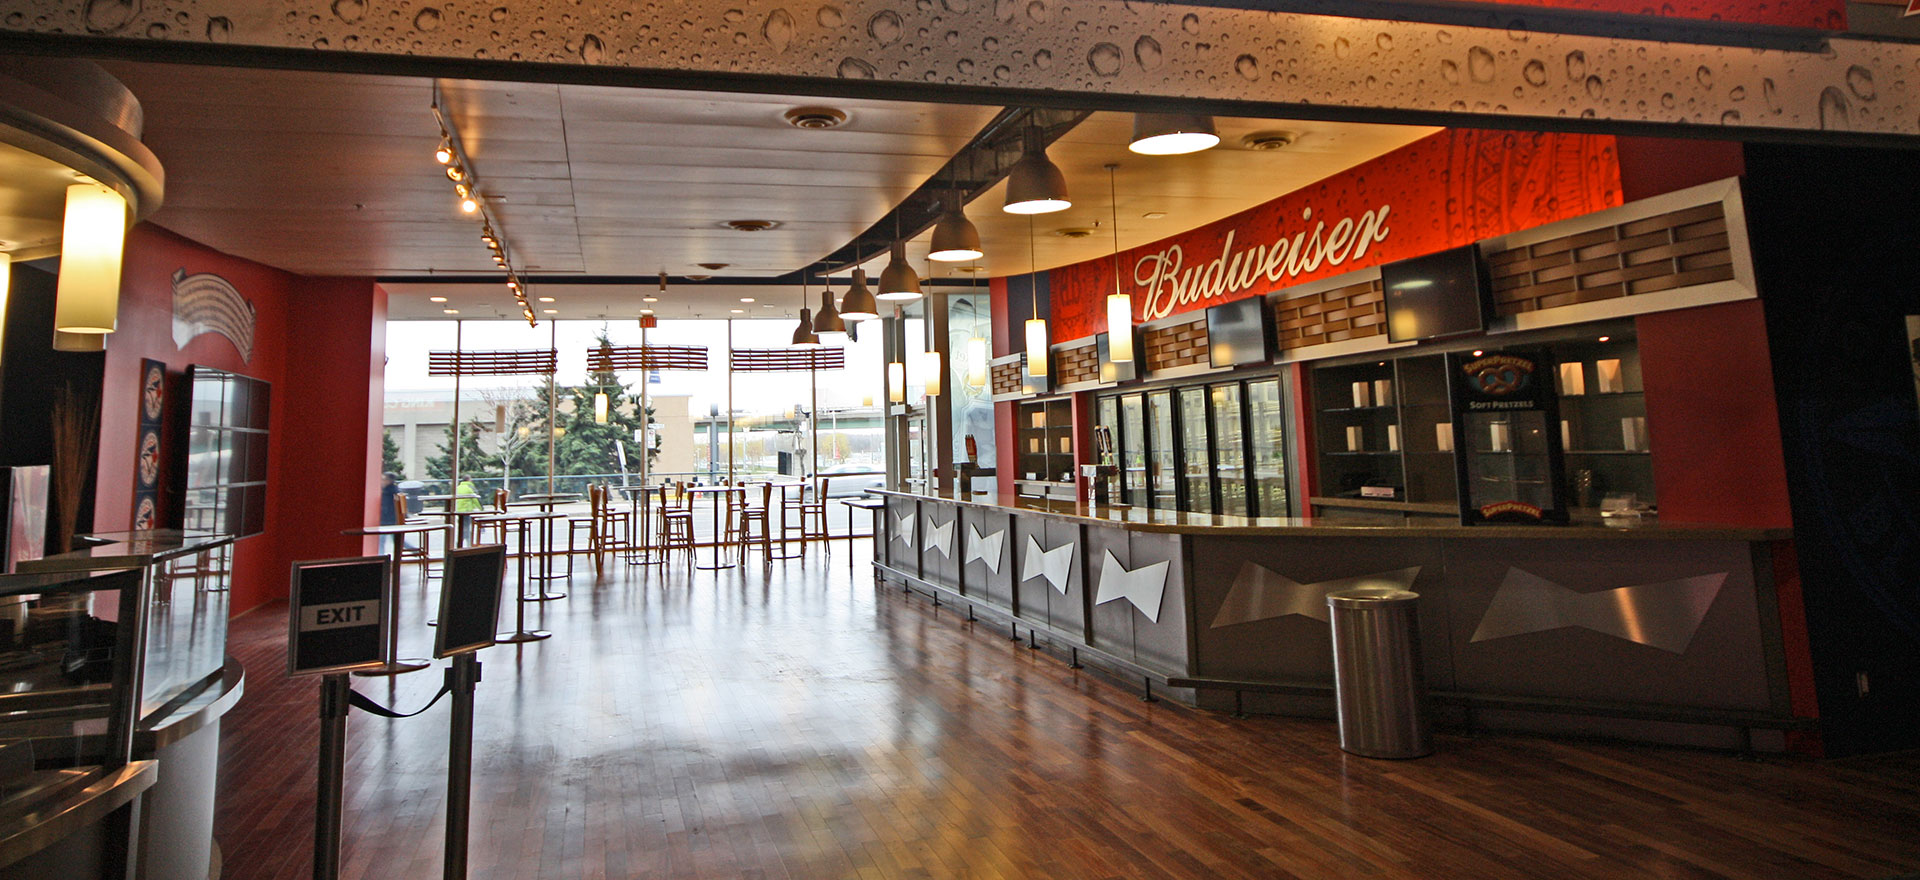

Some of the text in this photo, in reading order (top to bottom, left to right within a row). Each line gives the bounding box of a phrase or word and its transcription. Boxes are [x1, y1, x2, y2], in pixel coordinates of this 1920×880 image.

[1134, 205, 1390, 321] Budweiser
[1469, 400, 1534, 409] SOFT PRETZELS
[317, 605, 366, 625] EXIT
